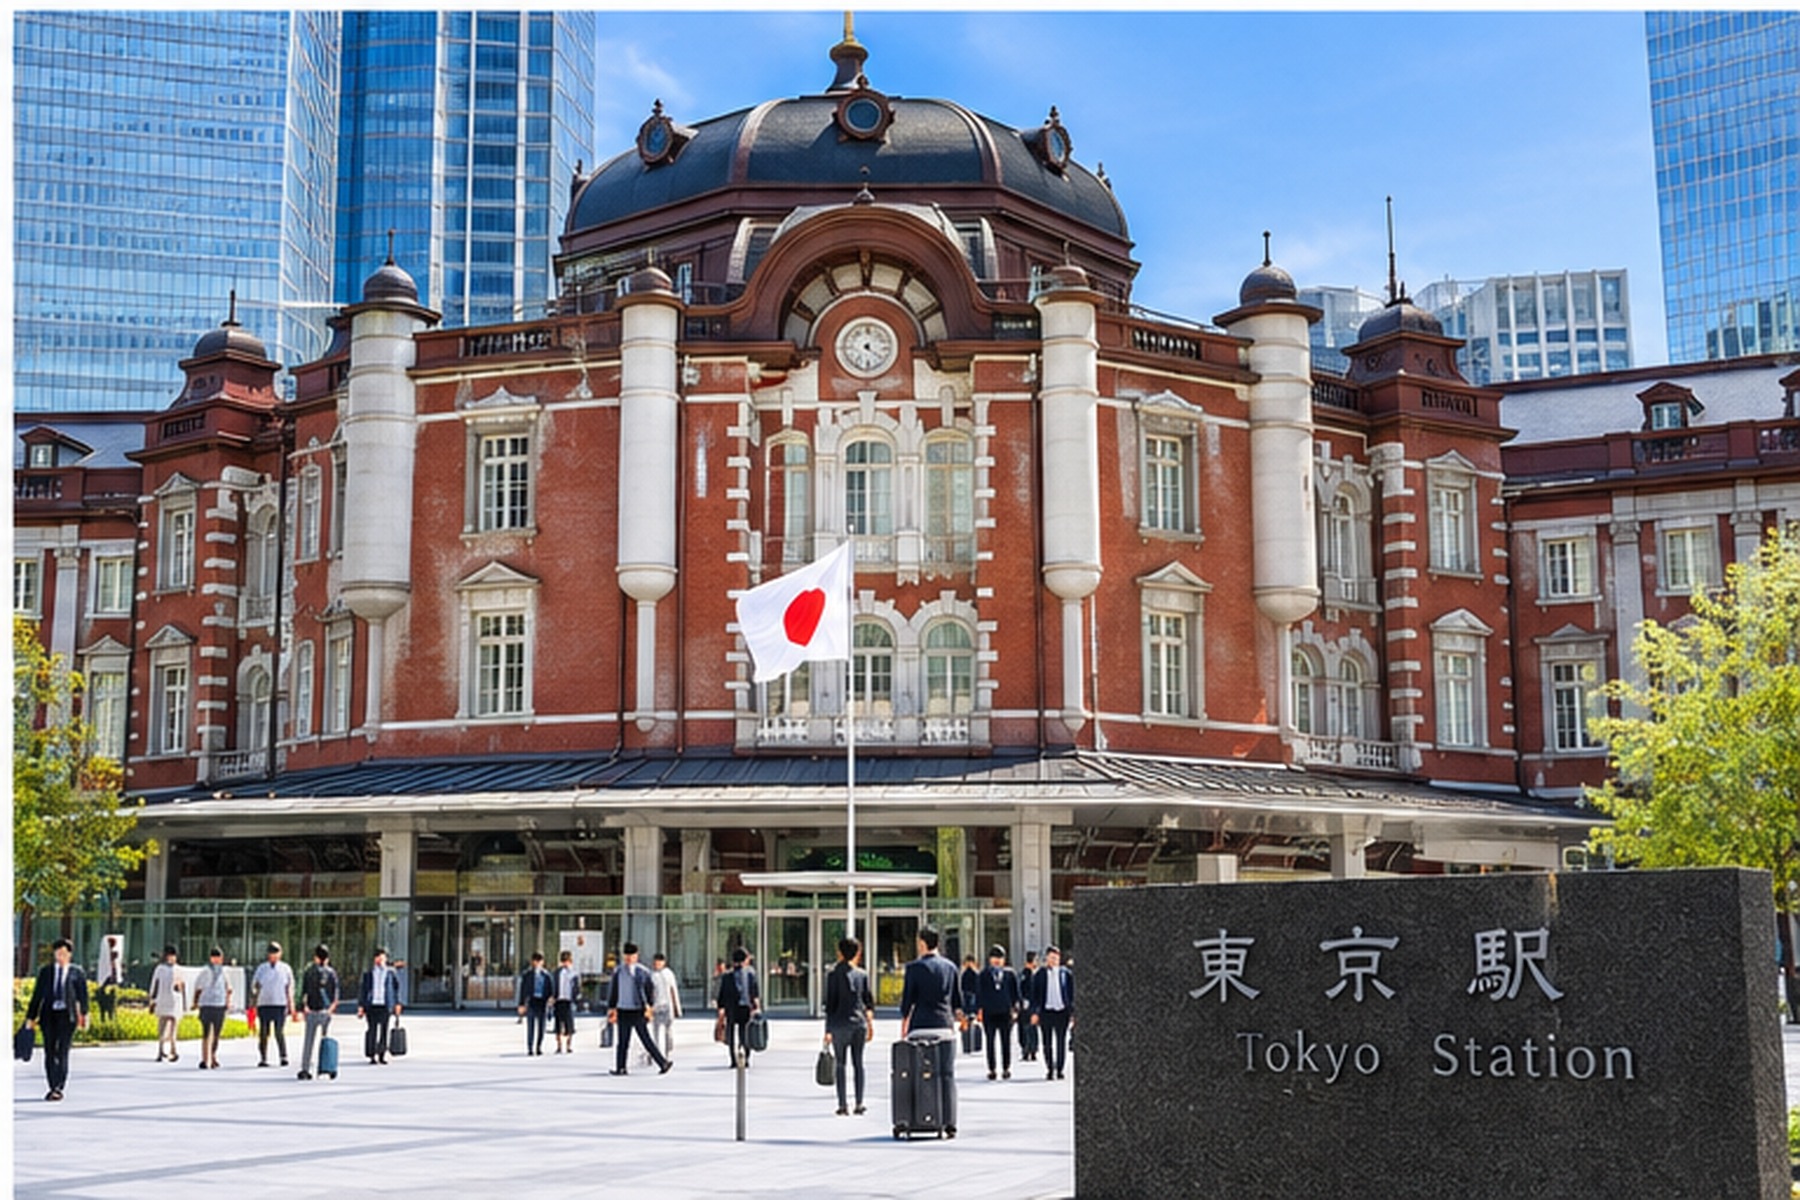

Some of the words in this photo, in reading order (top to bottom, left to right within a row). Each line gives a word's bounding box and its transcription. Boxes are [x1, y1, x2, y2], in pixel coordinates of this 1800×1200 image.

[1189, 926, 1565, 1003] 東京駅
[1237, 1030, 1381, 1084] Tokyo
[1432, 1033, 1636, 1081] Station
